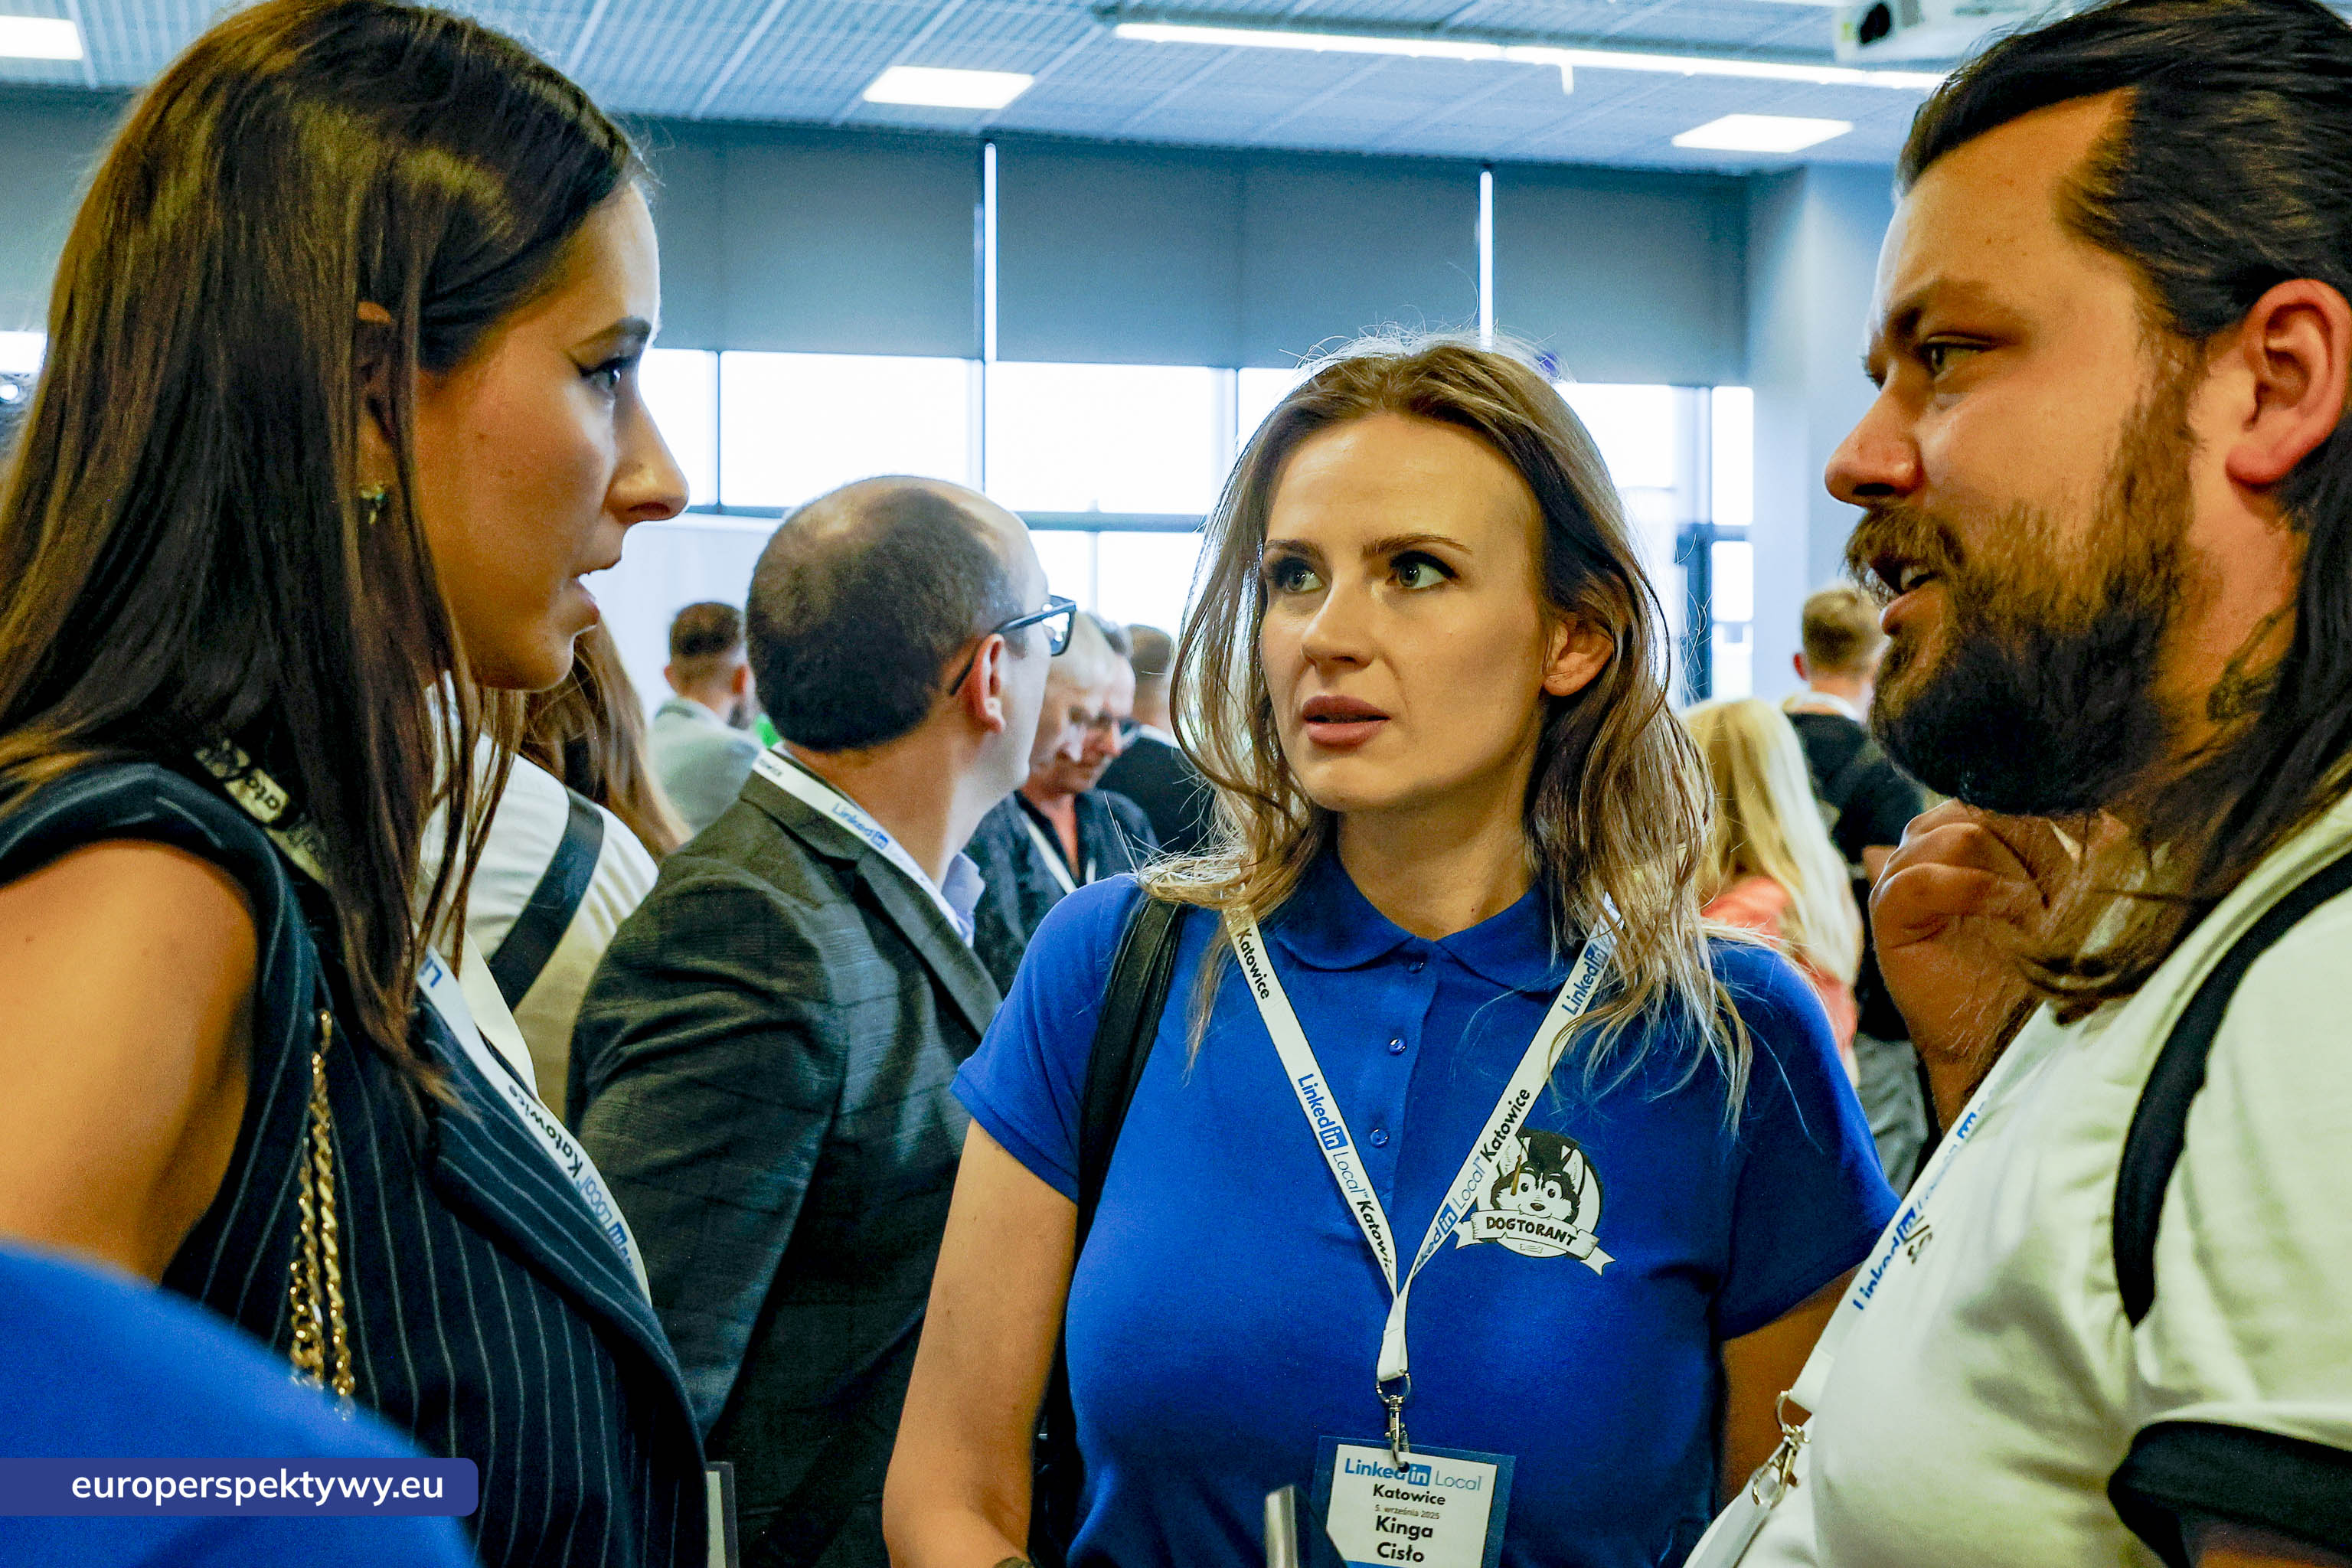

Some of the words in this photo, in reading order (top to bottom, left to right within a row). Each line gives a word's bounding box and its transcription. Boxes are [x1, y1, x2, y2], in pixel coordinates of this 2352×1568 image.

[1236, 927, 1270, 1000] Katowice
[1480, 1088, 1530, 1162] Katowice
[1298, 1073, 1348, 1150] Linkedin
[1357, 1200, 1393, 1283] Katowi
[1486, 1216, 1578, 1246] DOGTORANT
[1435, 1470, 1481, 1491] Local
[1373, 1484, 1446, 1506] Katowice
[1375, 1515, 1433, 1541] Kinga
[1377, 1542, 1425, 1562] Cisło
